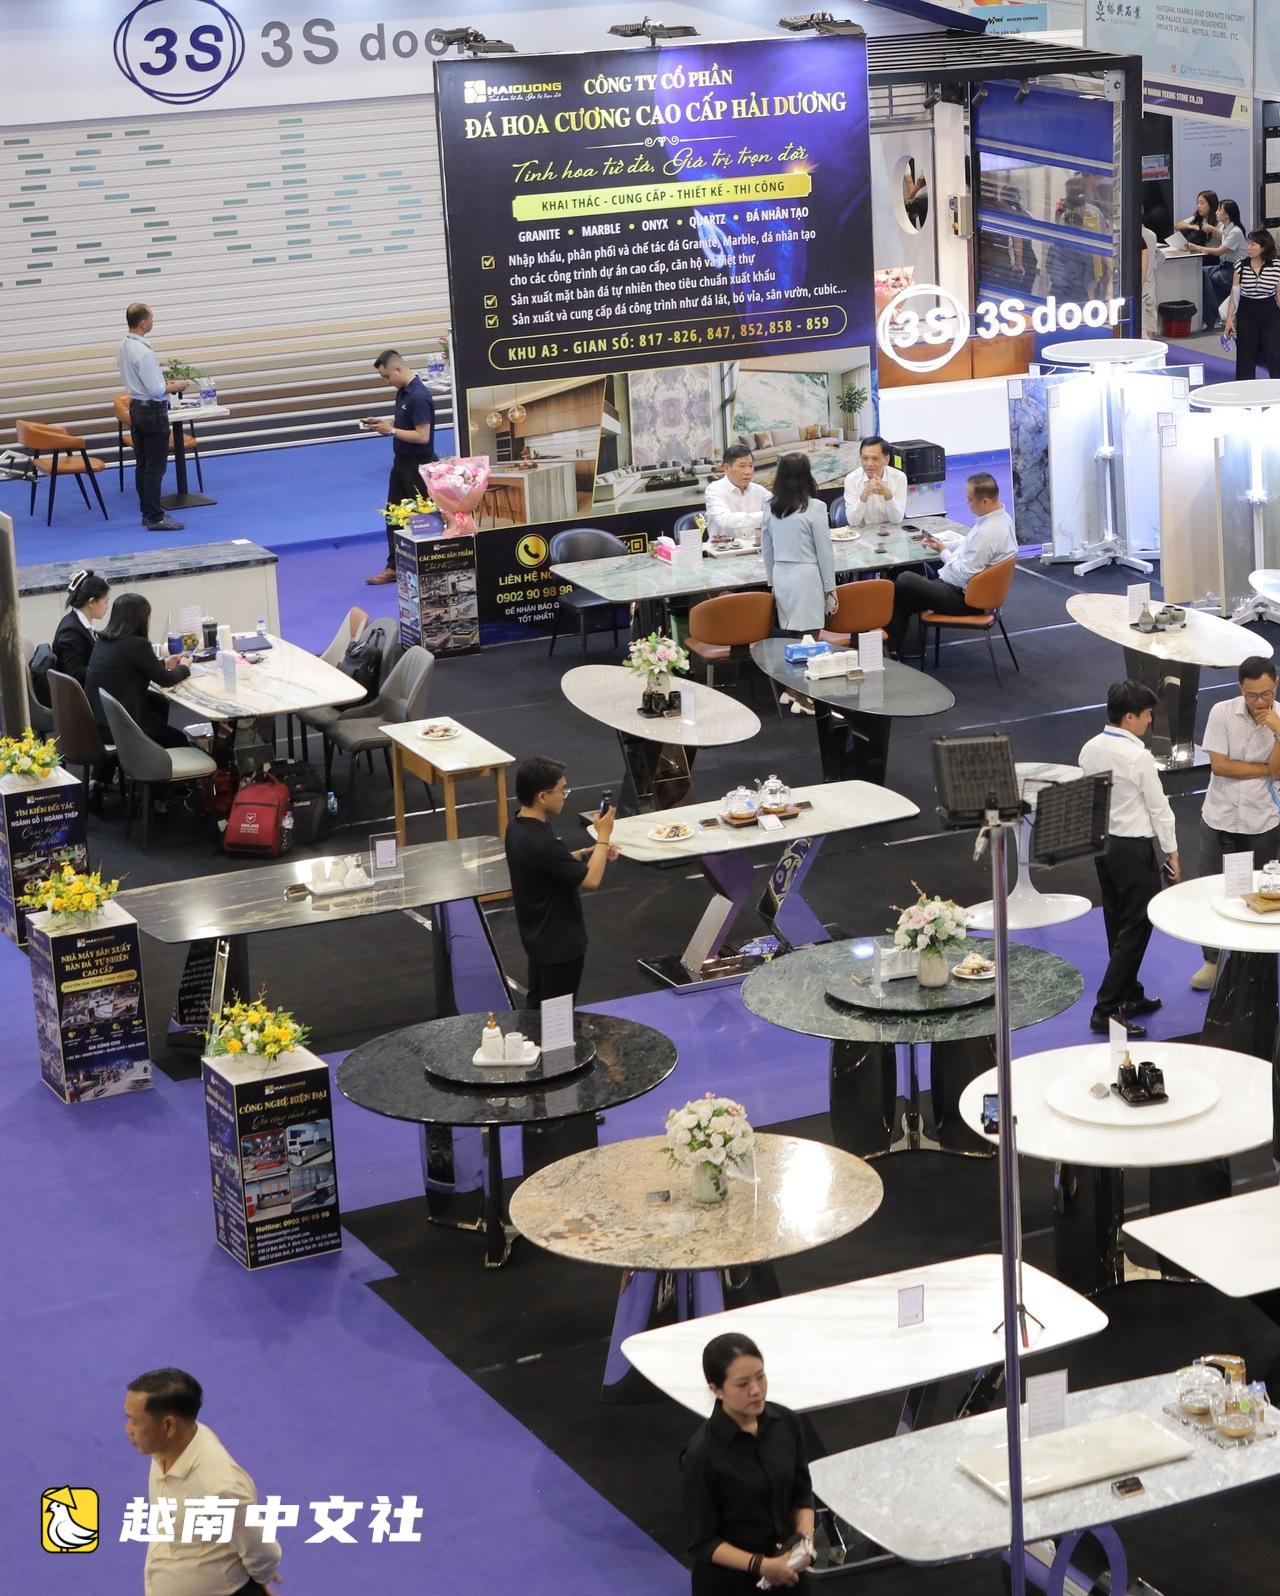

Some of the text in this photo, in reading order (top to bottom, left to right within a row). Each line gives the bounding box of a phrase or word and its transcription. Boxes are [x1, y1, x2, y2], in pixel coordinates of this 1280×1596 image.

[139, 24, 224, 76] 3S
[260, 18, 339, 68] 3S
[488, 82, 562, 95] HAIDUONG
[584, 63, 733, 95] CÔNG TY CỔ PHẦN
[464, 91, 847, 139] ĐÁ HOA CƯƠNG CAO CẤP HẢI DƯƠNG
[512, 143, 809, 183] Tinh hoa từ đá, Giá trị trọn đời
[541, 180, 785, 212] KHAI THÁC CUNG CẤP THIẾT KẾ THI CÔNG
[518, 207, 809, 242] GRANITE MARBLE ONYX QUARTZ ĐÁ NHÂN TẠO
[509, 229, 816, 267] Nhập khẩu, phân phối và chế tác đá Granite, Marble, đá nhân tạo
[512, 282, 847, 326] Sản xuất và cung cấp đá công trình như đá lát, bó vỉa, sân vườn, cubic...
[976, 295, 1126, 340] 3S door
[508, 348, 536, 361] KHU
[541, 344, 558, 358] A3
[573, 339, 607, 354] GIAN
[612, 332, 635, 350] SỐ:
[639, 333, 663, 347] 817
[707, 326, 736, 341] 847,
[807, 316, 829, 330] 859
[894, 307, 951, 348] 3S
[496, 591, 524, 604] 0902
[526, 589, 540, 600] 90
[543, 587, 557, 597] 98
[499, 574, 521, 586] LIÊN
[524, 571, 538, 582] HỆ
[518, 614, 532, 623] TỐT
[538, 602, 552, 611] BÁO
